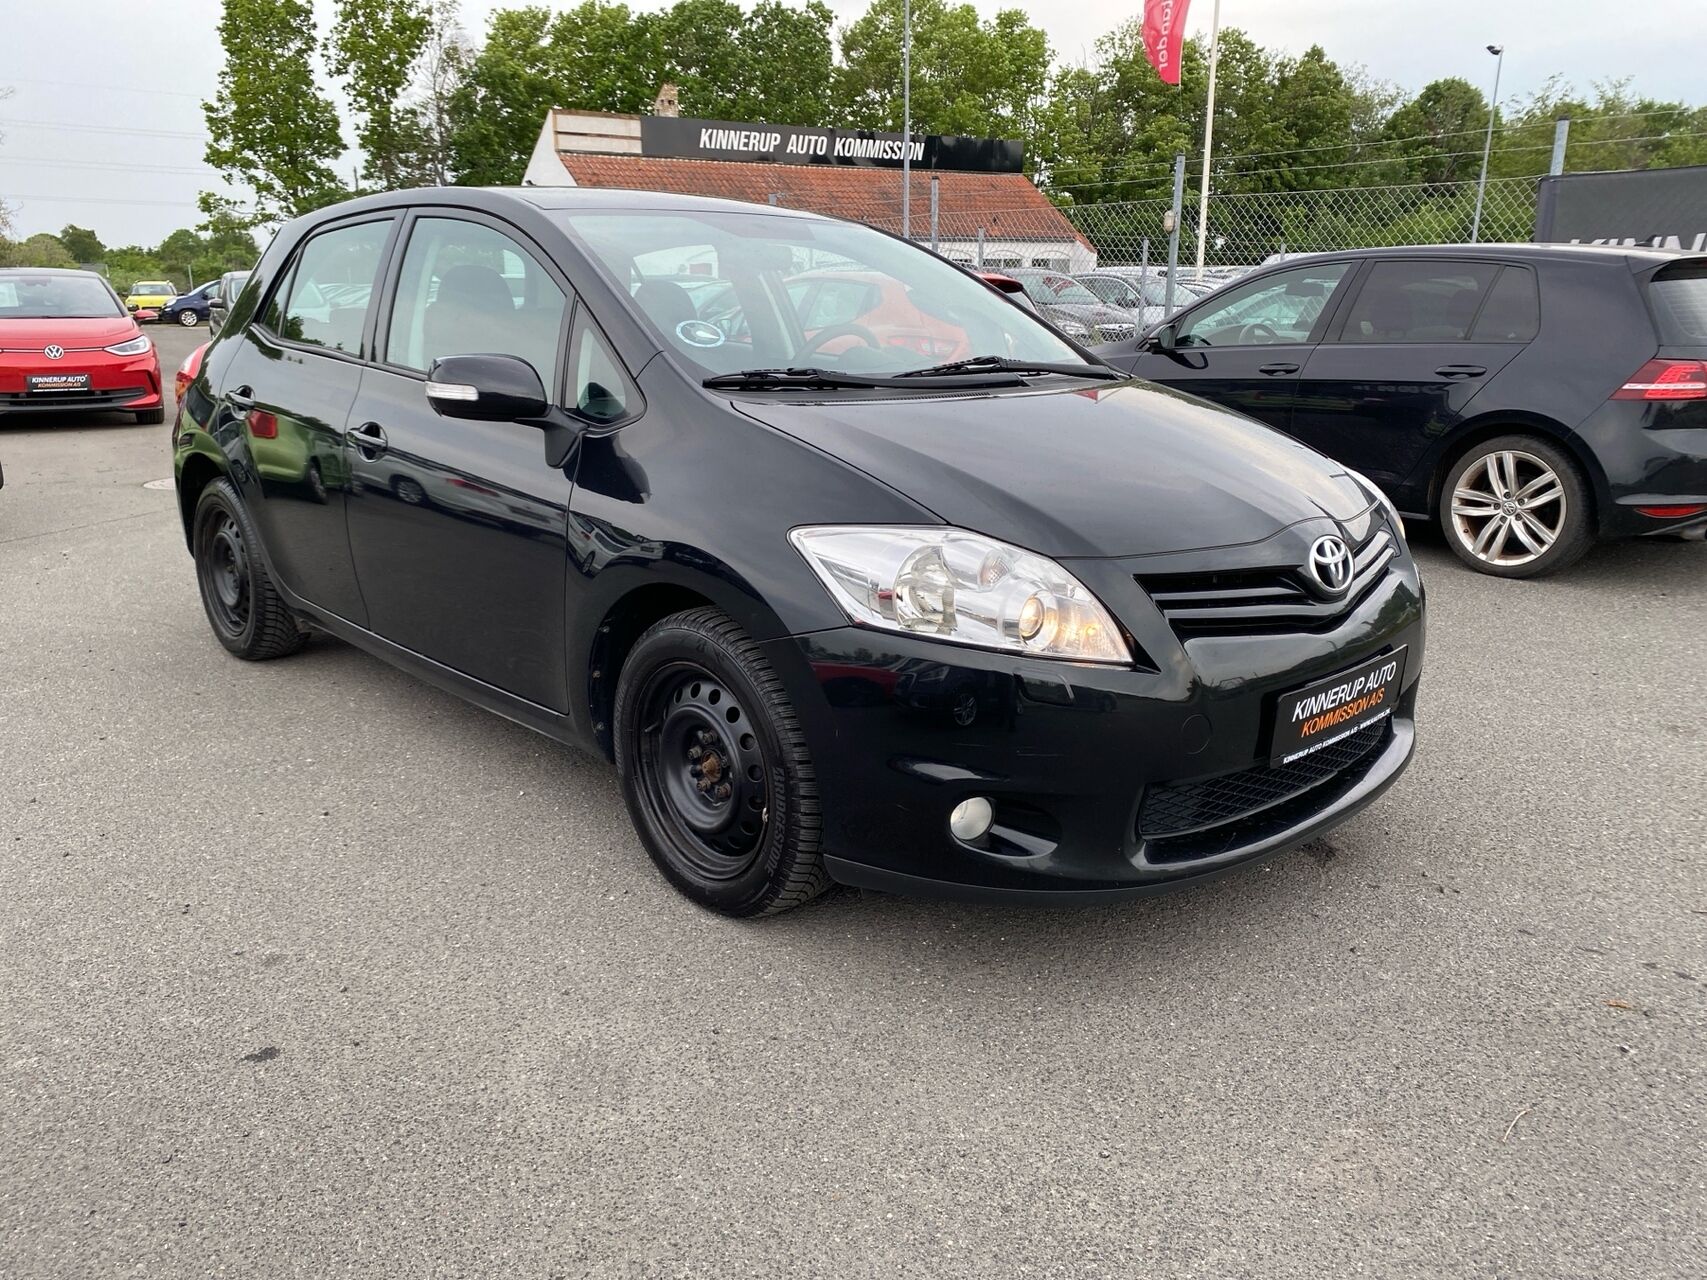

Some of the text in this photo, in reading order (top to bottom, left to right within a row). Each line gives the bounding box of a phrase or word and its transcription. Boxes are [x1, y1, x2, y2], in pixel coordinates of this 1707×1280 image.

[700, 128, 781, 152] KINNERUP
[786, 134, 828, 156] AUTO
[1292, 677, 1365, 722] KINNERUP
[1364, 661, 1397, 694] AUTO
[1301, 694, 1372, 738] KOMMISSION
[765, 767, 786, 877] BRIDGESTONE
